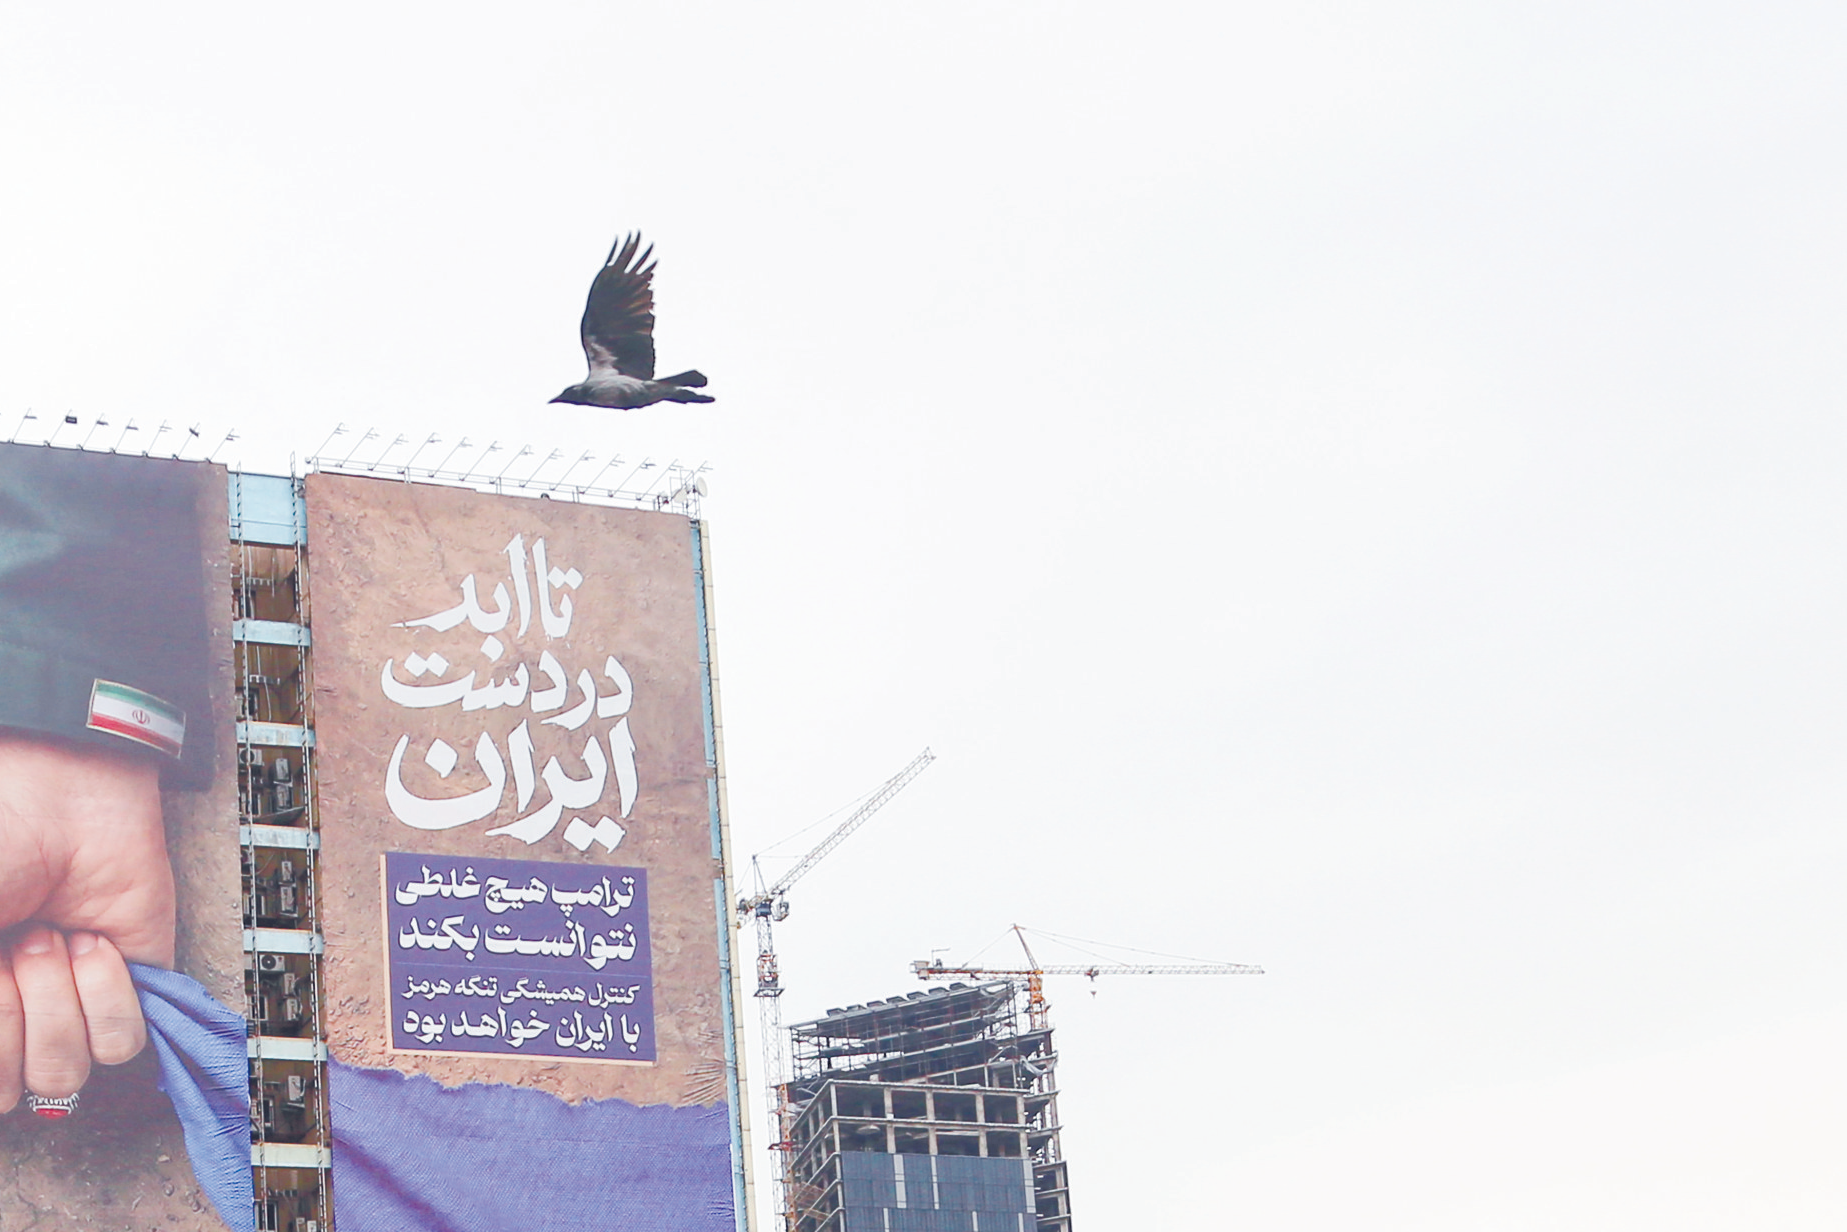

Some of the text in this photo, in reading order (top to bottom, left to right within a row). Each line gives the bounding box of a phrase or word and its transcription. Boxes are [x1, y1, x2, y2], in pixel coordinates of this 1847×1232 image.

[384, 716, 639, 854] ایران
[394, 864, 636, 918] ترامپ هیچ غلطی
[397, 914, 638, 971] نتوانست بکند
[400, 975, 642, 1009] کنترل همیشگی تنگه هرمز
[402, 1005, 642, 1053] با ایران خواهد بود
